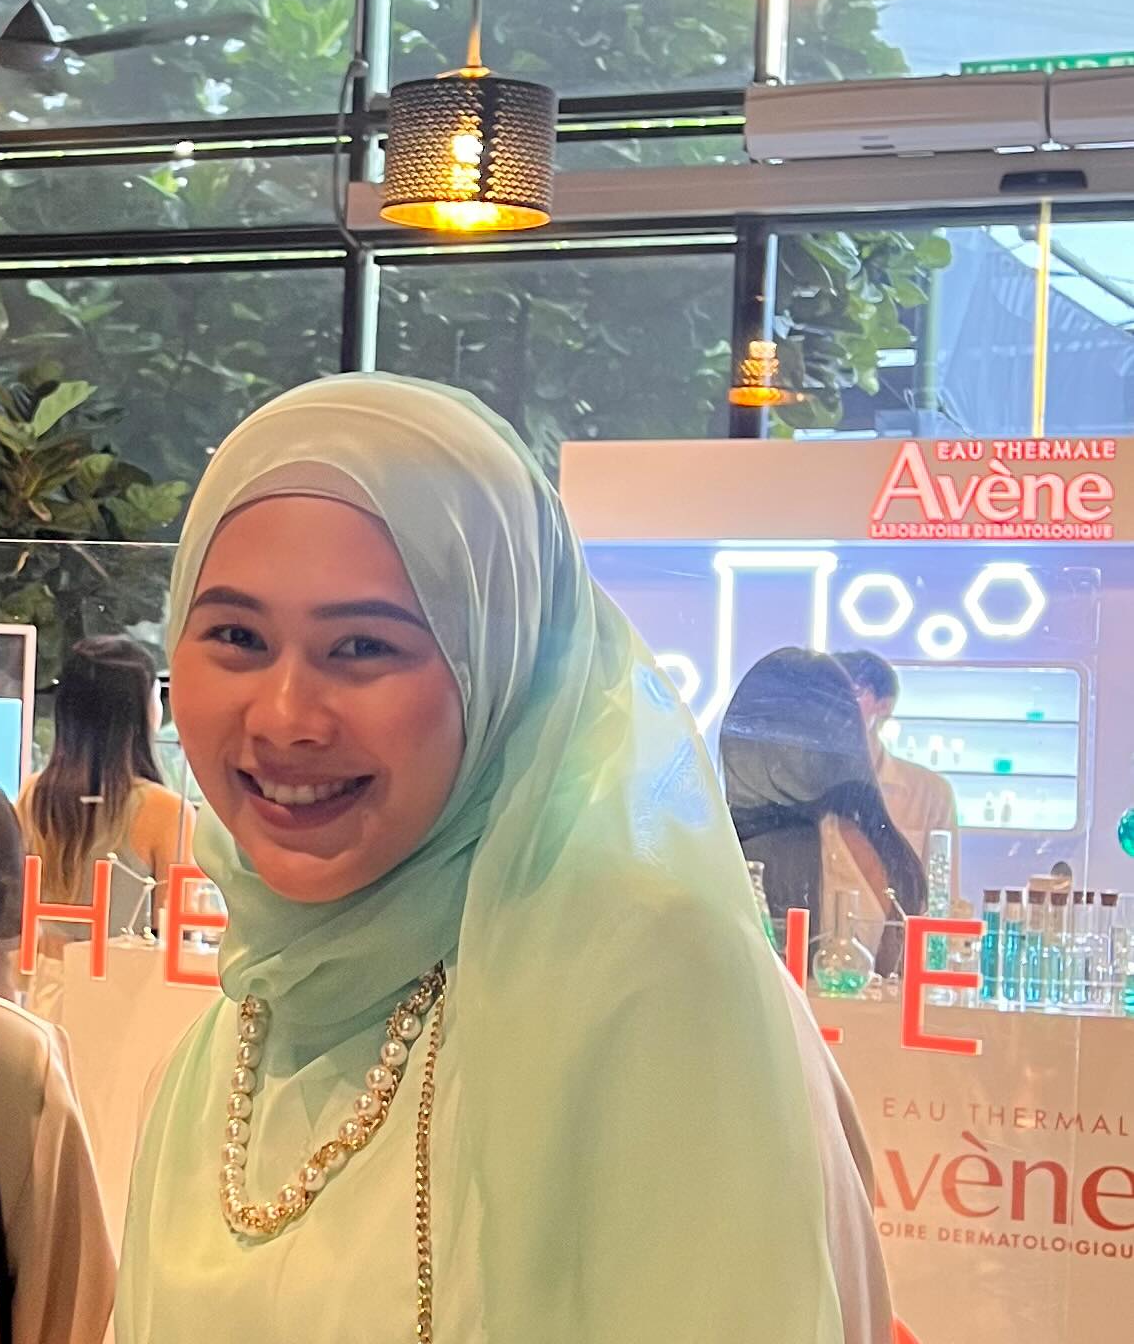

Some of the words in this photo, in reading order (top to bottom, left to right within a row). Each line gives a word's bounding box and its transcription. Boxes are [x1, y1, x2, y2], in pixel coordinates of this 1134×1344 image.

[937, 441, 983, 460] EAU
[993, 440, 1116, 460] THERMALE
[872, 441, 1115, 522] Avène
[882, 1097, 946, 1122] EAU
[969, 1102, 1129, 1137] THERMAL
[875, 1131, 1134, 1232] vène
[938, 1227, 1134, 1260] DERMATOLOGIQU
